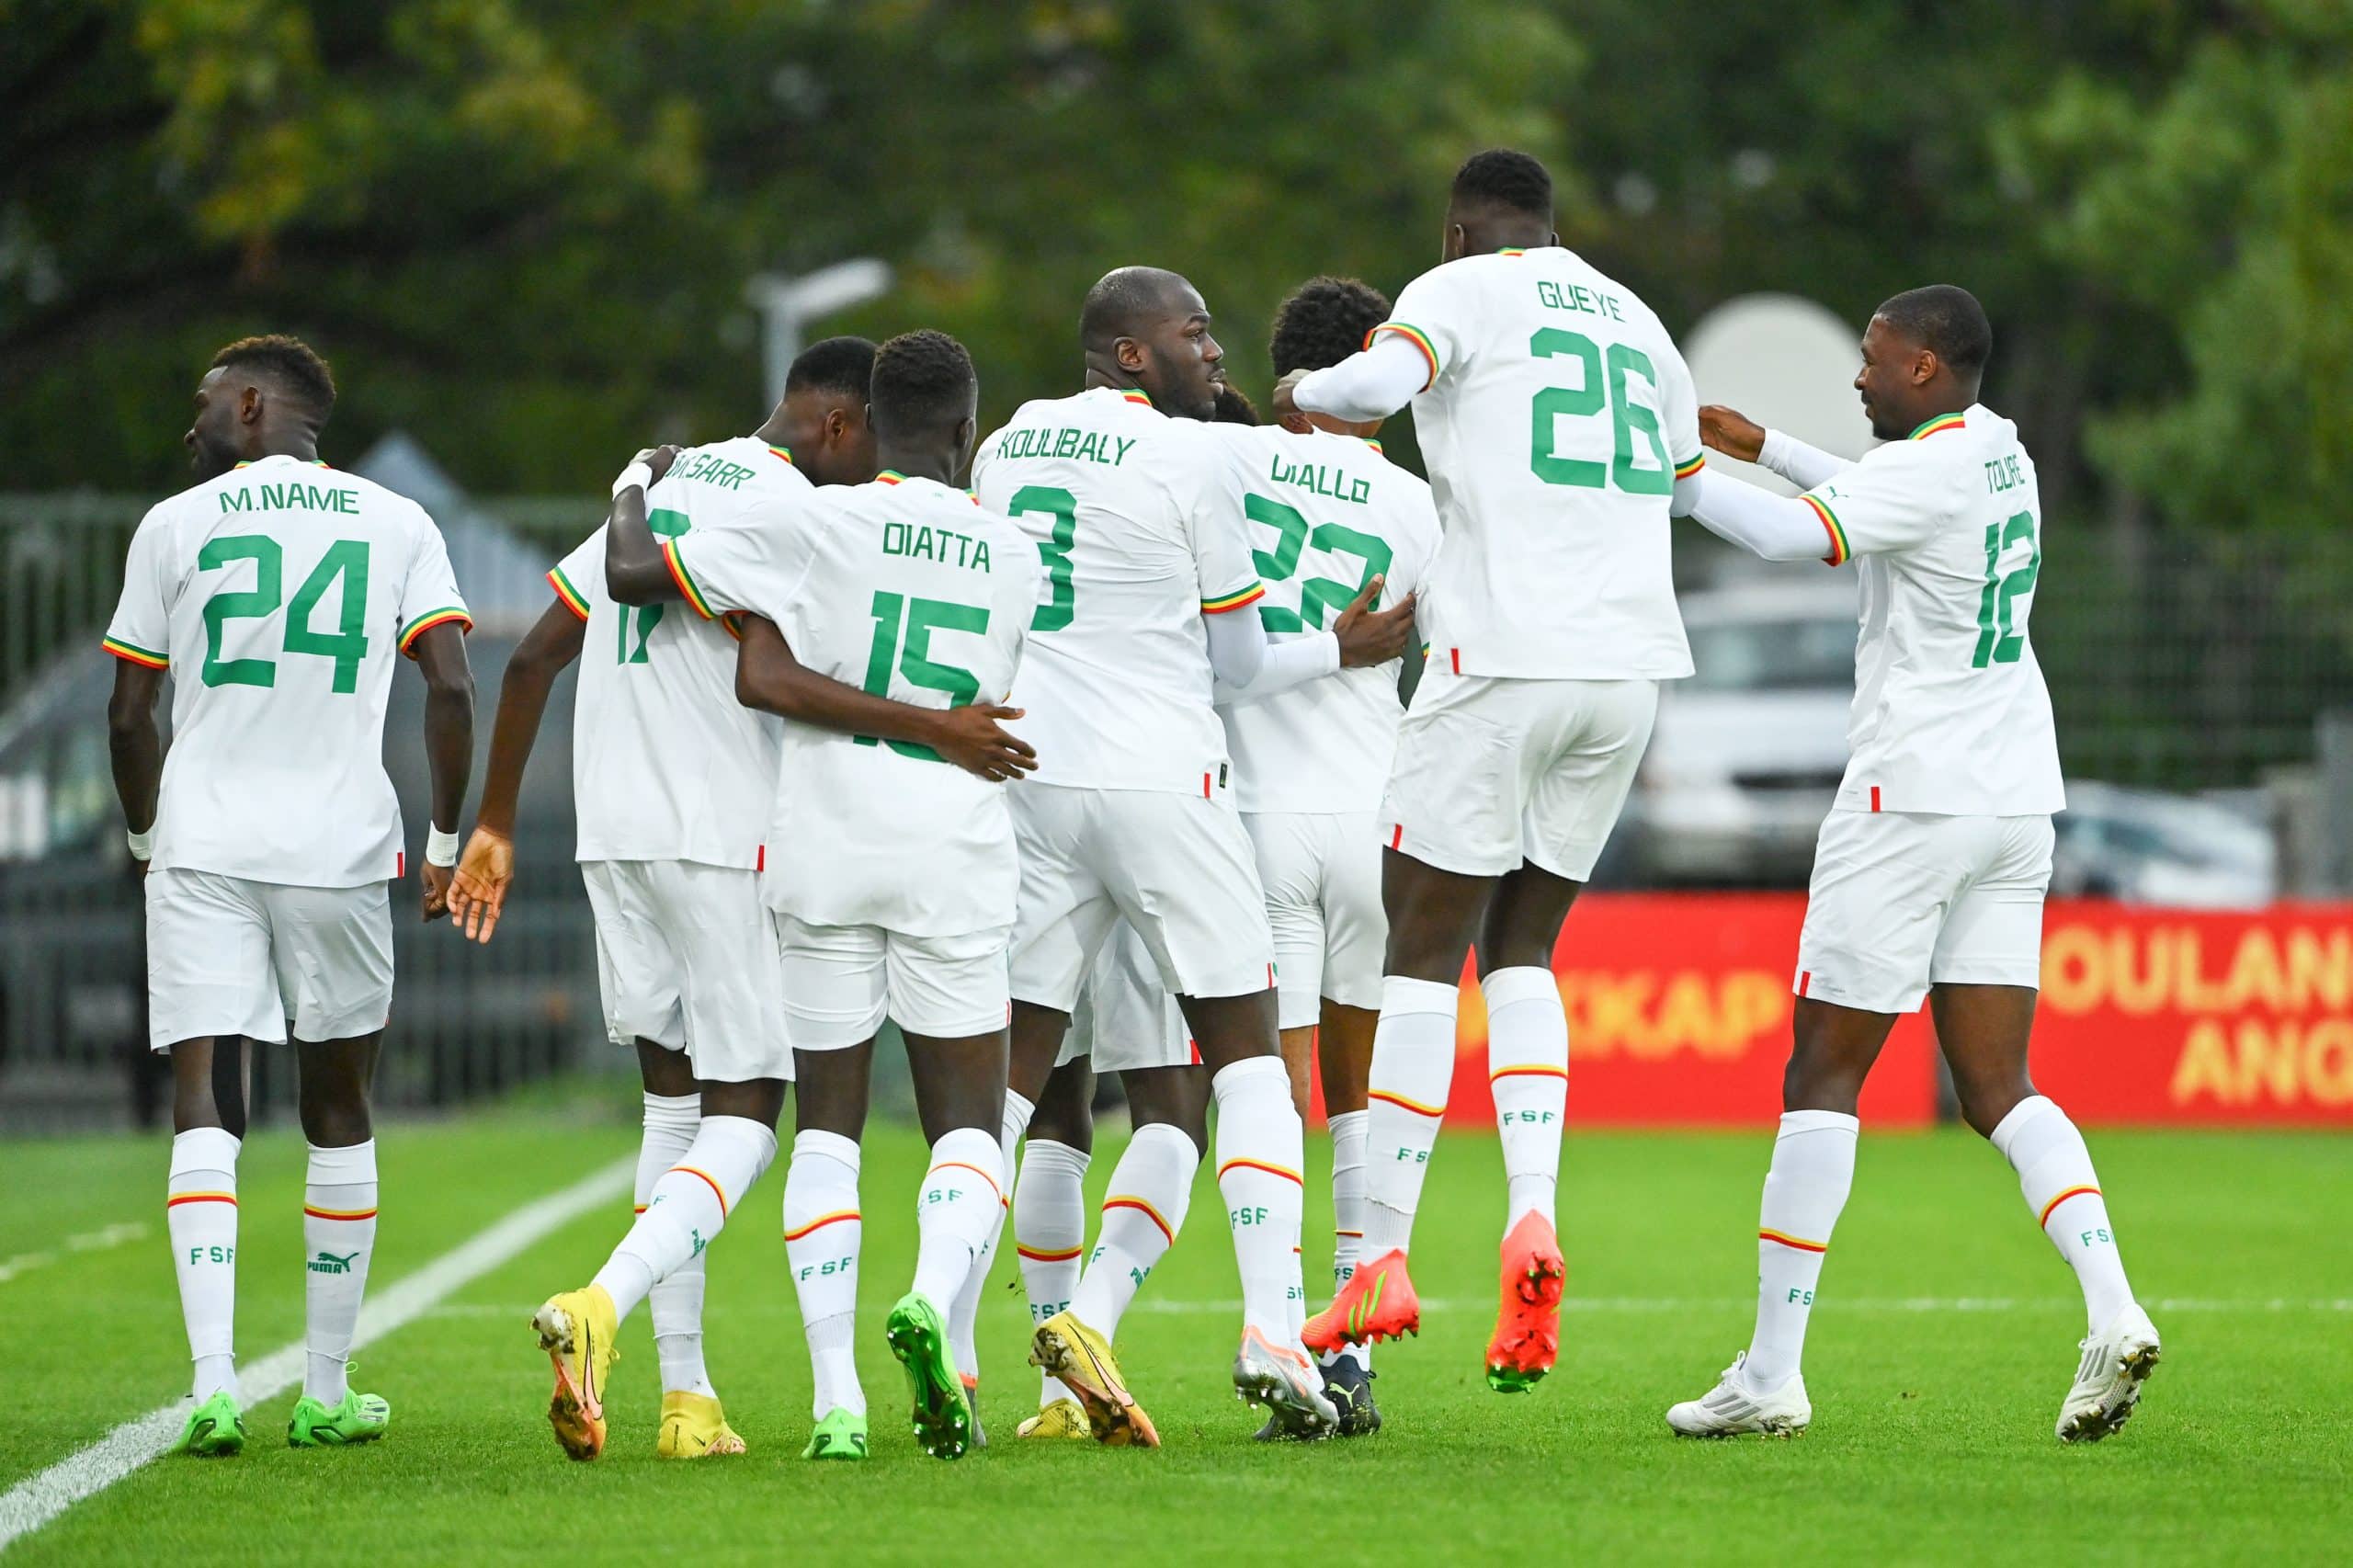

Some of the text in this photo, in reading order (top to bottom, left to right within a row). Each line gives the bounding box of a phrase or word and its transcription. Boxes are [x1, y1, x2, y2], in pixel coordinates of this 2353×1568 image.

[1537, 280, 1625, 323] GUEYE
[1530, 327, 1672, 495] 26
[996, 427, 1136, 467] KOULIBALY
[1271, 453, 1370, 505] DIALLO
[1984, 453, 2025, 494] TOURE
[219, 483, 360, 515] M.NAME
[882, 522, 991, 574] DIATTA
[1007, 485, 1077, 632] 3
[1244, 492, 1393, 633] 22
[1972, 510, 2040, 669] 12
[197, 534, 371, 695] 24
[853, 590, 991, 762] 15
[1504, 1109, 1554, 1126] FSF
[1397, 1147, 1427, 1163] FS
[1231, 1207, 1268, 1230] FSF
[2081, 1229, 2115, 1247] FS
[307, 1261, 343, 1275] PUMA
[801, 1256, 853, 1281] FSF
[1335, 1267, 1353, 1280] FS
[1788, 1288, 1813, 1305] FS
